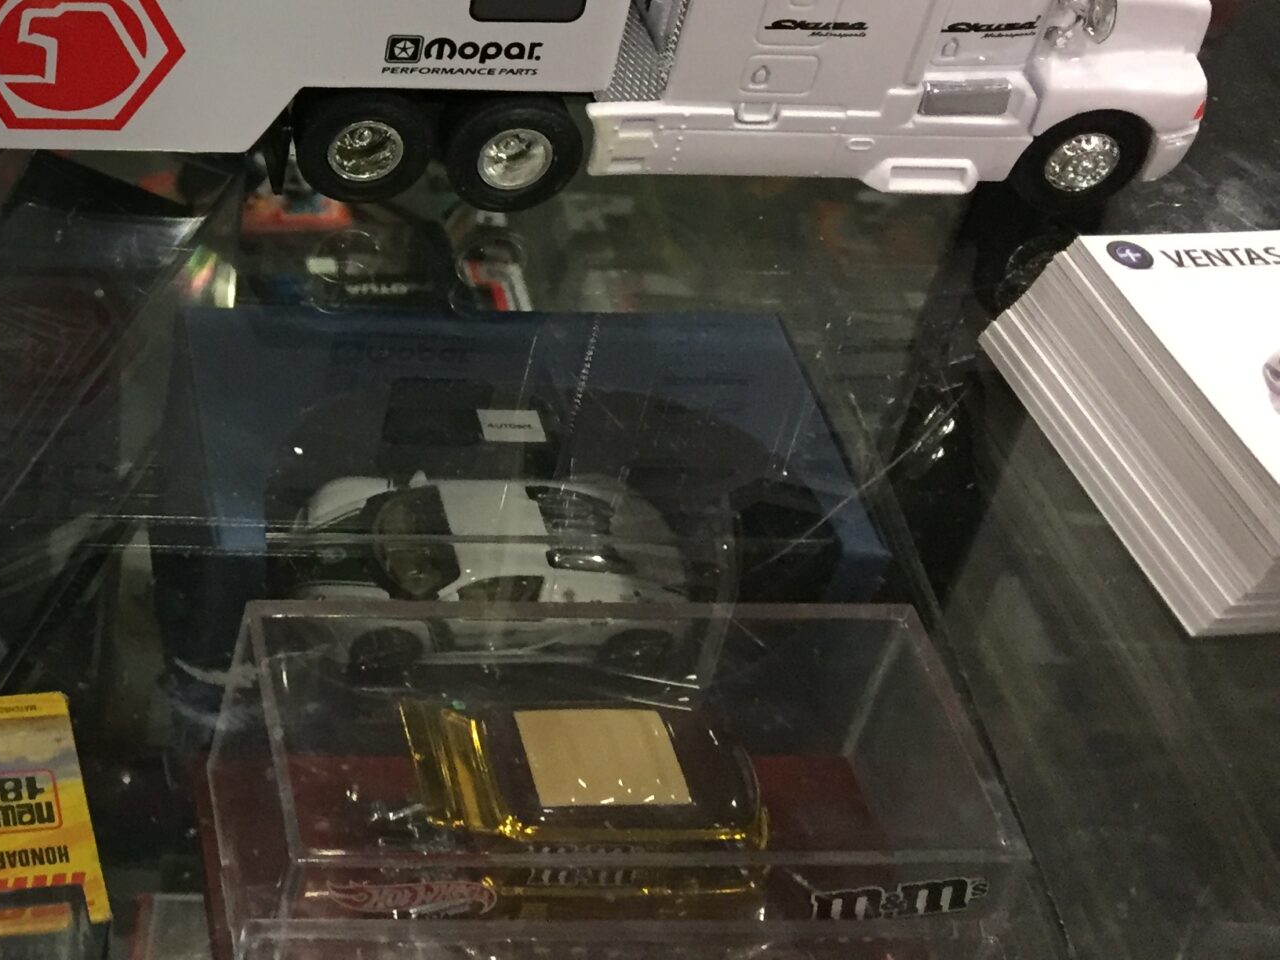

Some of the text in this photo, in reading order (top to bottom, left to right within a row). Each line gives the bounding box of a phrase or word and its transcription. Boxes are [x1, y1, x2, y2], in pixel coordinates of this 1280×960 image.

[381, 66, 538, 77] PERFORMANCE PARTS
[1159, 246, 1280, 268] VENTAS
